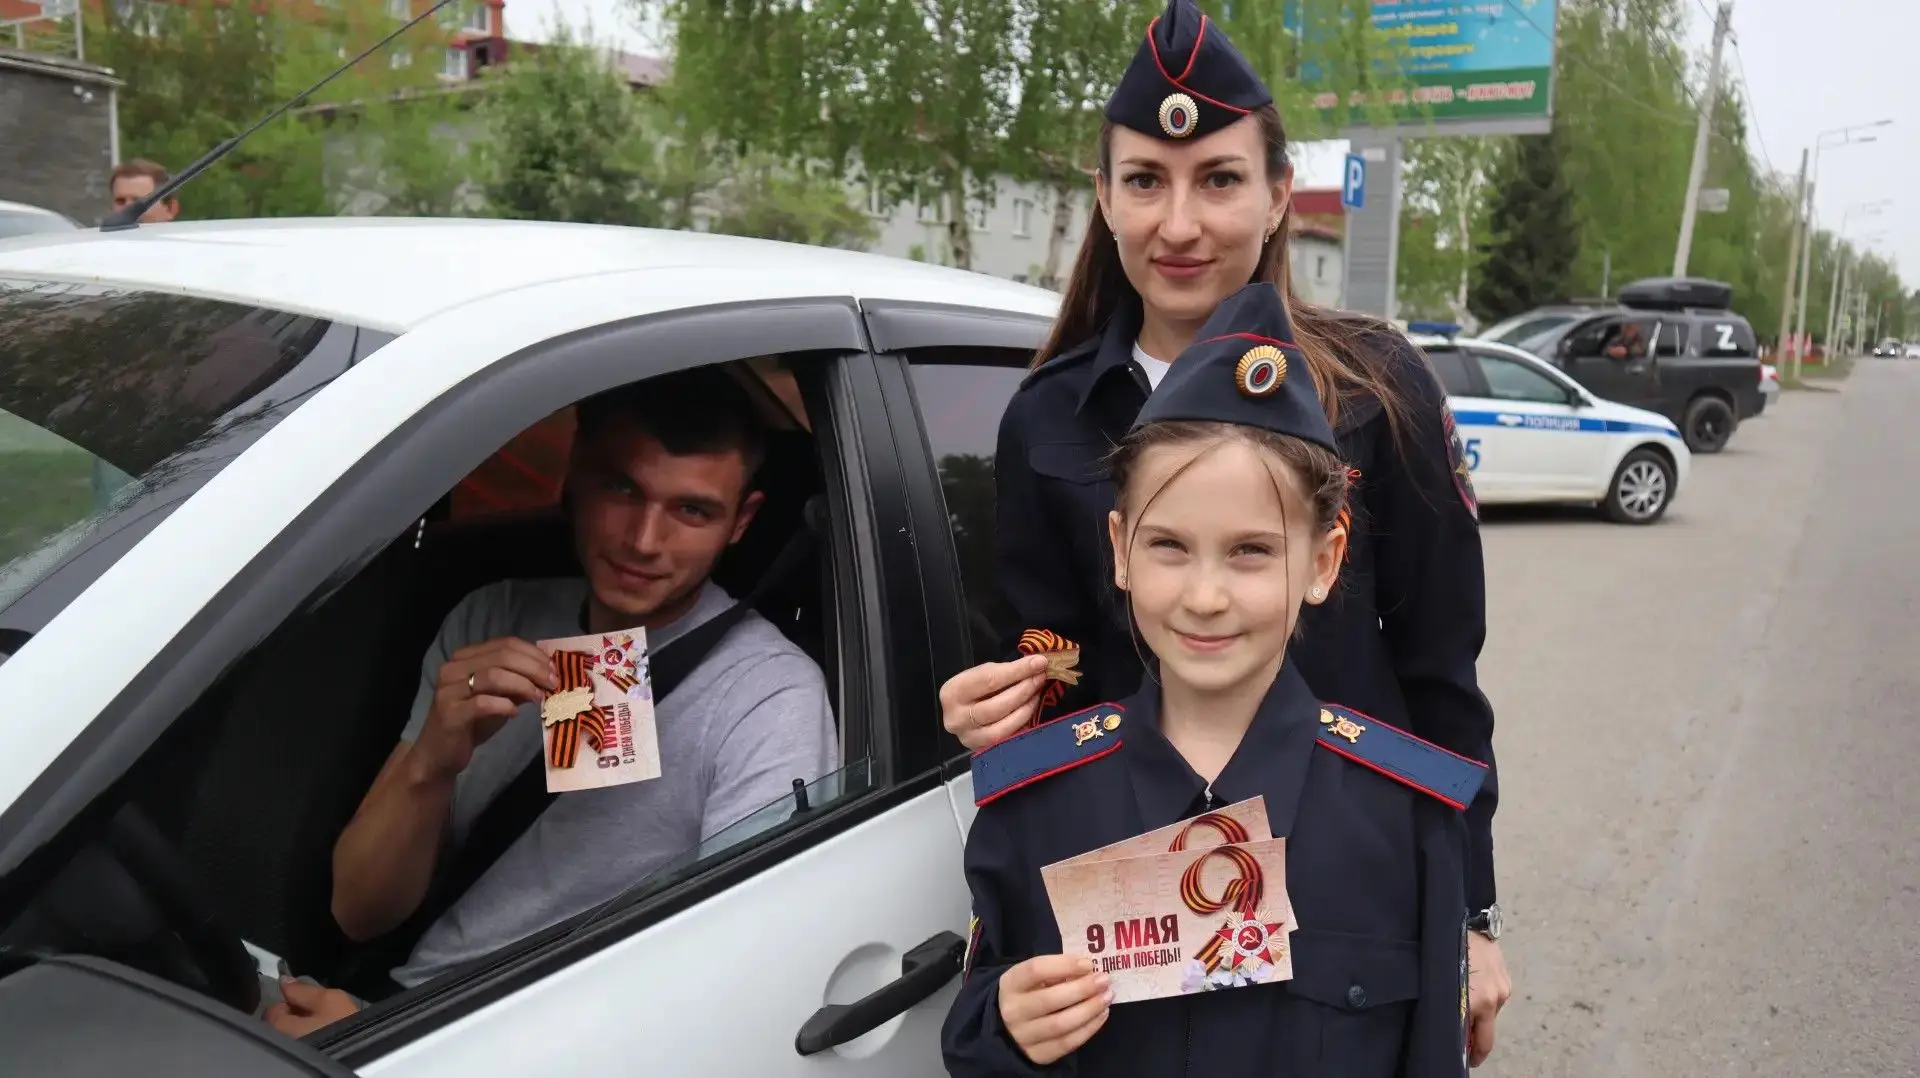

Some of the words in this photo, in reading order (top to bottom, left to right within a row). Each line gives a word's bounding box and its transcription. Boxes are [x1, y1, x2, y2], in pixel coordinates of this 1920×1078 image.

[1347, 159, 1363, 203] P
[1715, 324, 1737, 350] Z
[618, 702, 632, 735] ПОБЕДЫ!
[622, 737, 636, 757] ДНЕМ
[598, 755, 620, 769] 9
[1087, 924, 1105, 953] 9
[1114, 914, 1179, 950] МАЯ
[1102, 955, 1131, 974] ДНЕМ
[1134, 947, 1181, 968] ПОБЕДЫ!
